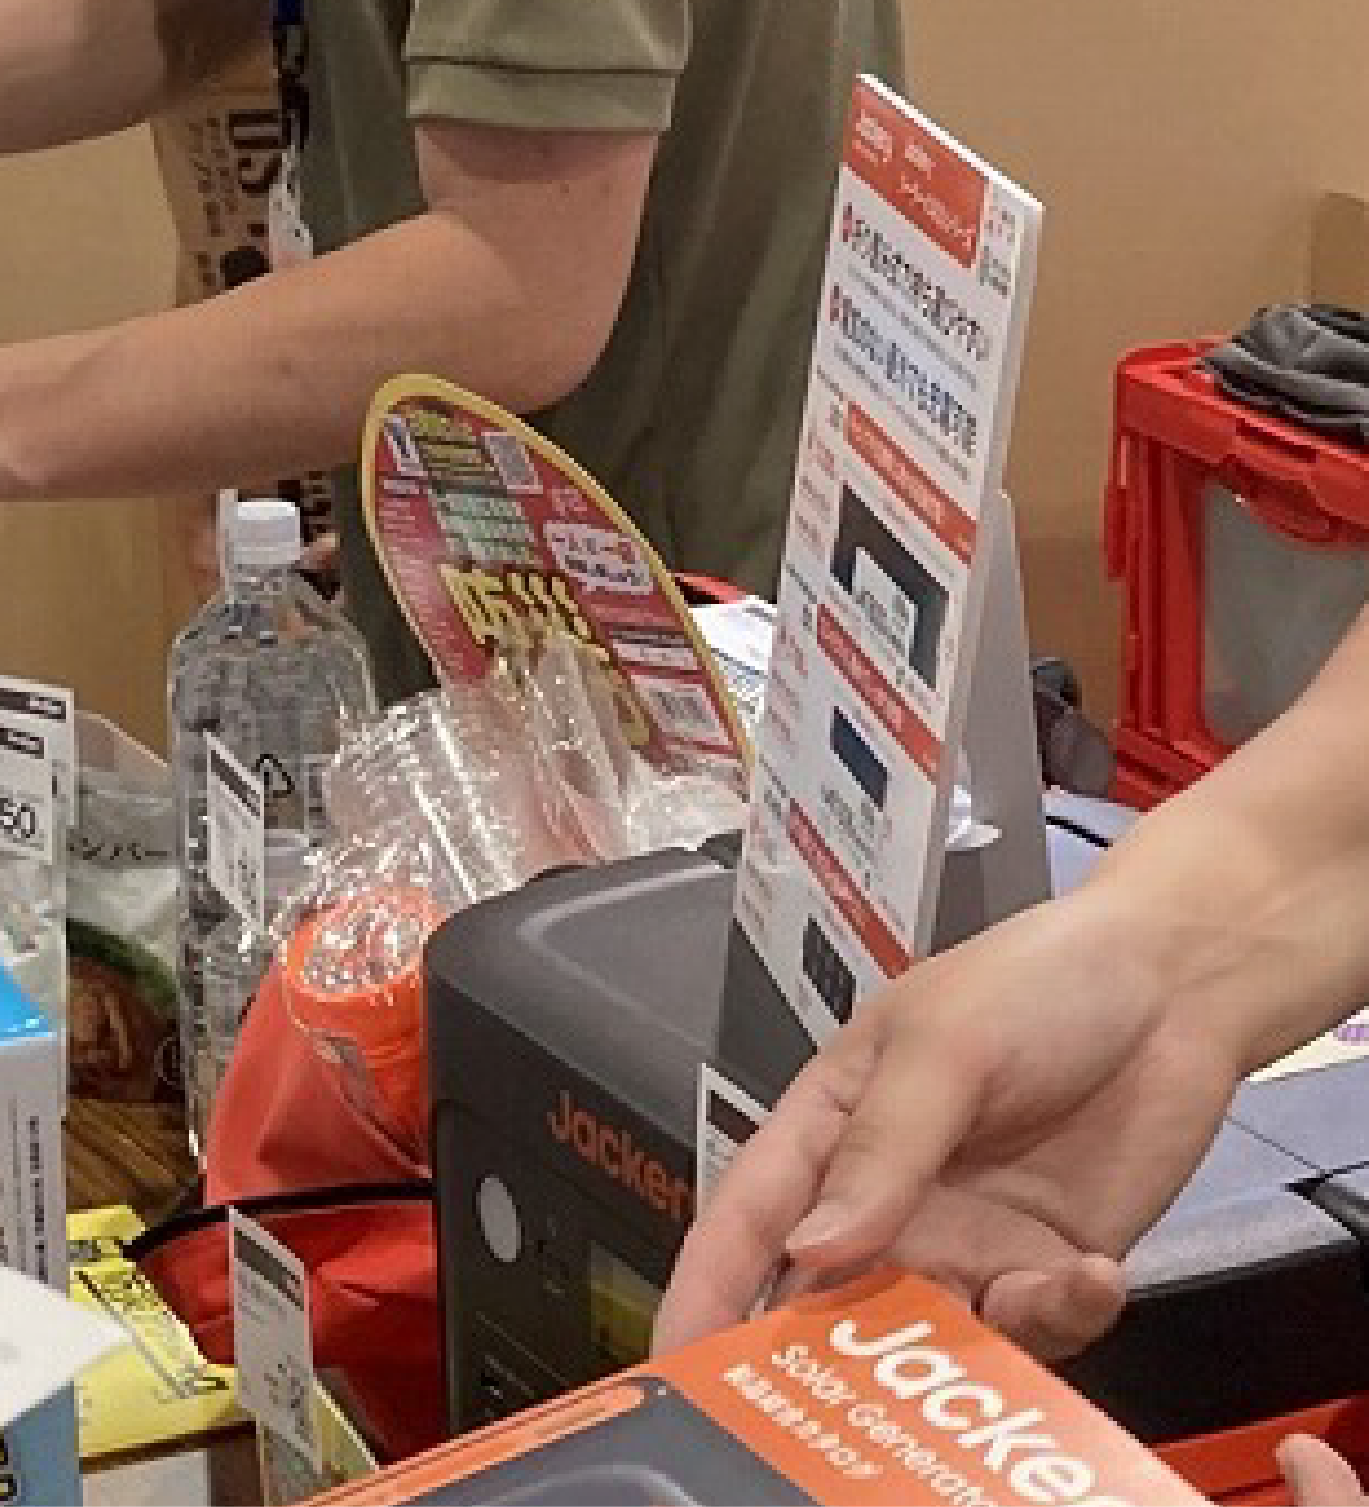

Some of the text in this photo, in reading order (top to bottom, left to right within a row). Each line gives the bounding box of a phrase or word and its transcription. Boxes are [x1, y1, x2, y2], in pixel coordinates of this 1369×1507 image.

[546, 1090, 694, 1224] Jacker
[771, 1342, 857, 1409] Solar
[831, 1318, 1132, 1507] Jacke
